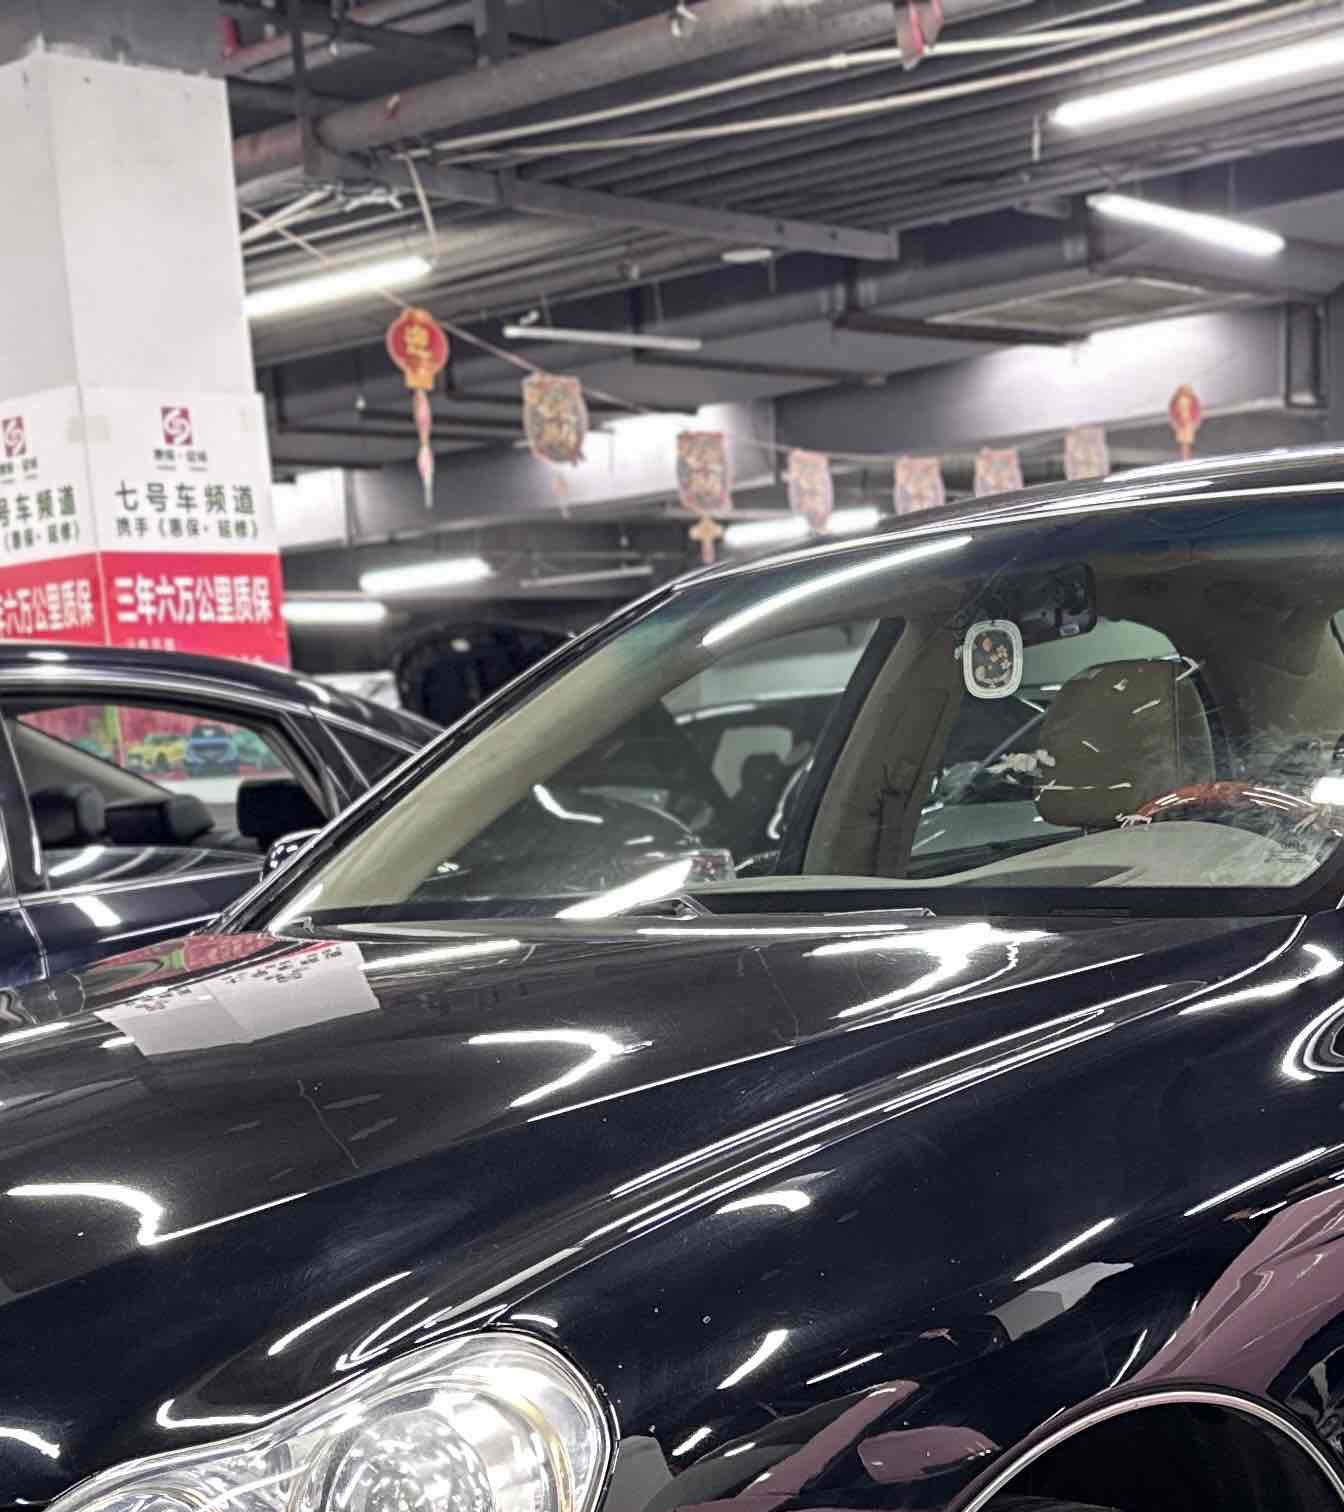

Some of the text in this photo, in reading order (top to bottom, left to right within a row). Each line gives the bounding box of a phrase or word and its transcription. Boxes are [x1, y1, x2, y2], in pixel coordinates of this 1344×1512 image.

[114, 480, 255, 515] 七号车频道
[113, 574, 273, 625] 三年六万公里质保
